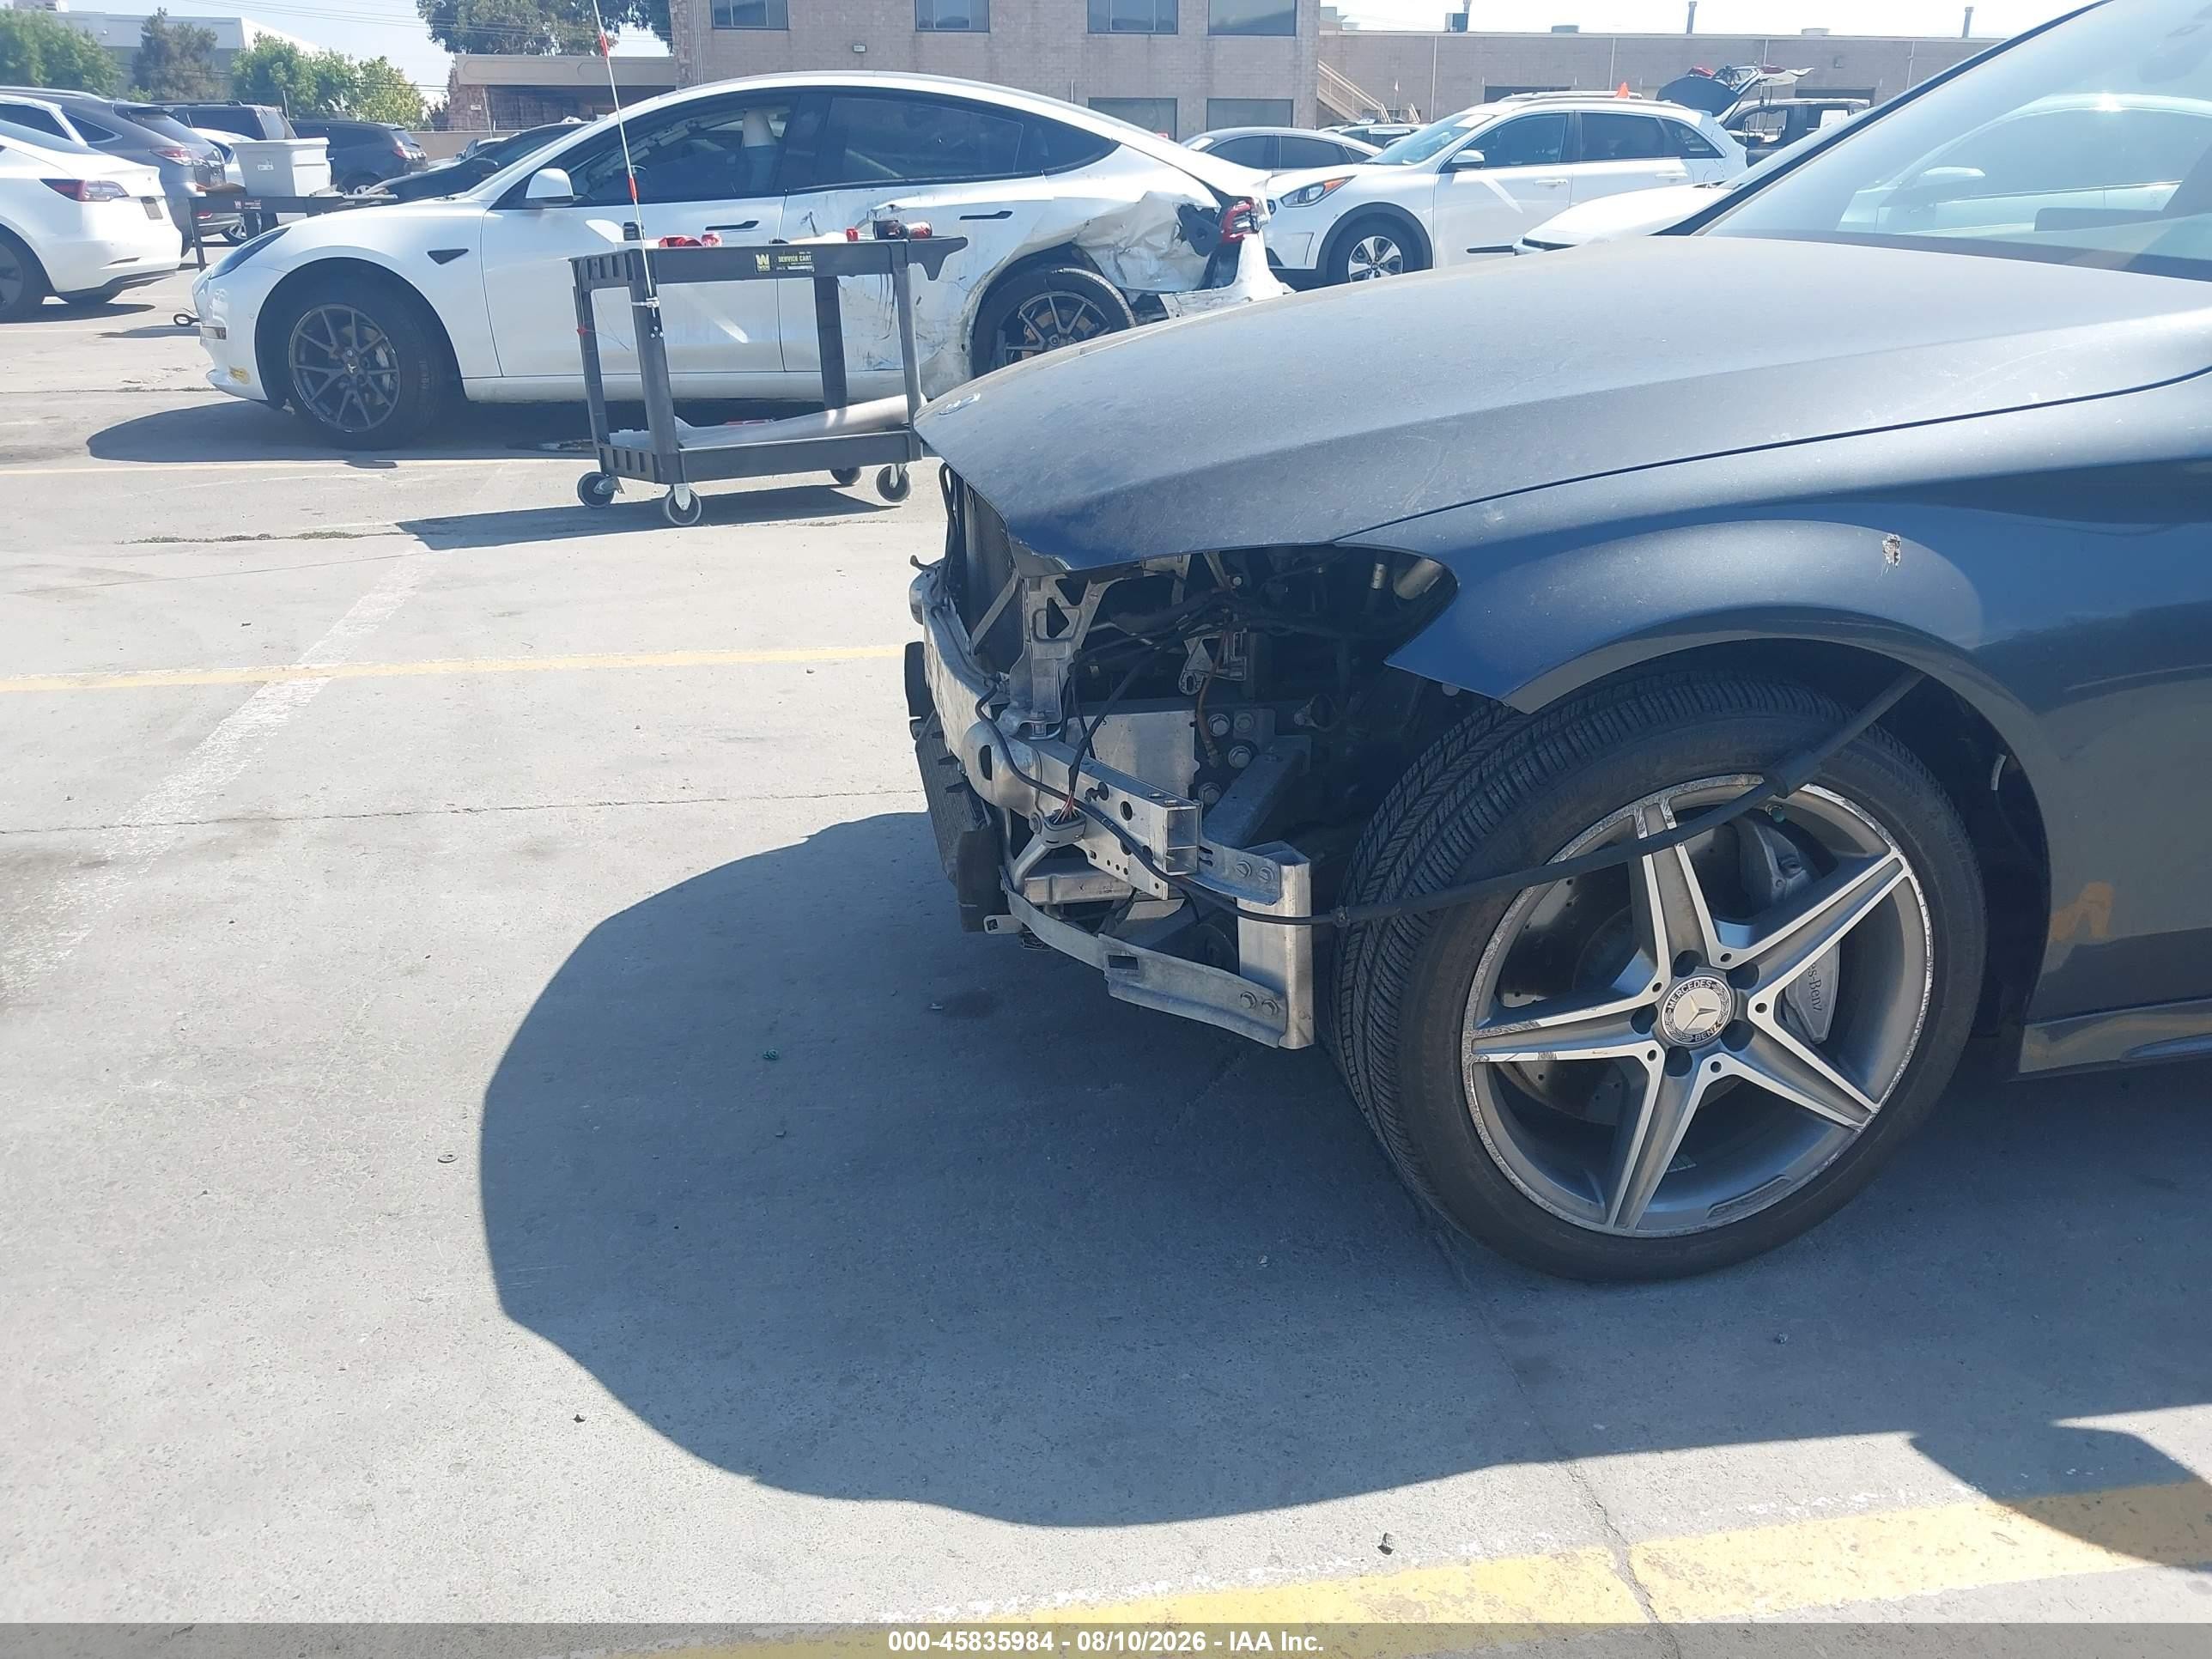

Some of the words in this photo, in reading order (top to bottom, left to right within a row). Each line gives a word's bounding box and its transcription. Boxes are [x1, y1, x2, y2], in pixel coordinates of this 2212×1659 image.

[1668, 980, 1712, 1009] MERCEDES
[1807, 962, 1823, 1013] es-Benz
[1695, 1022, 1720, 1042] BENZ
